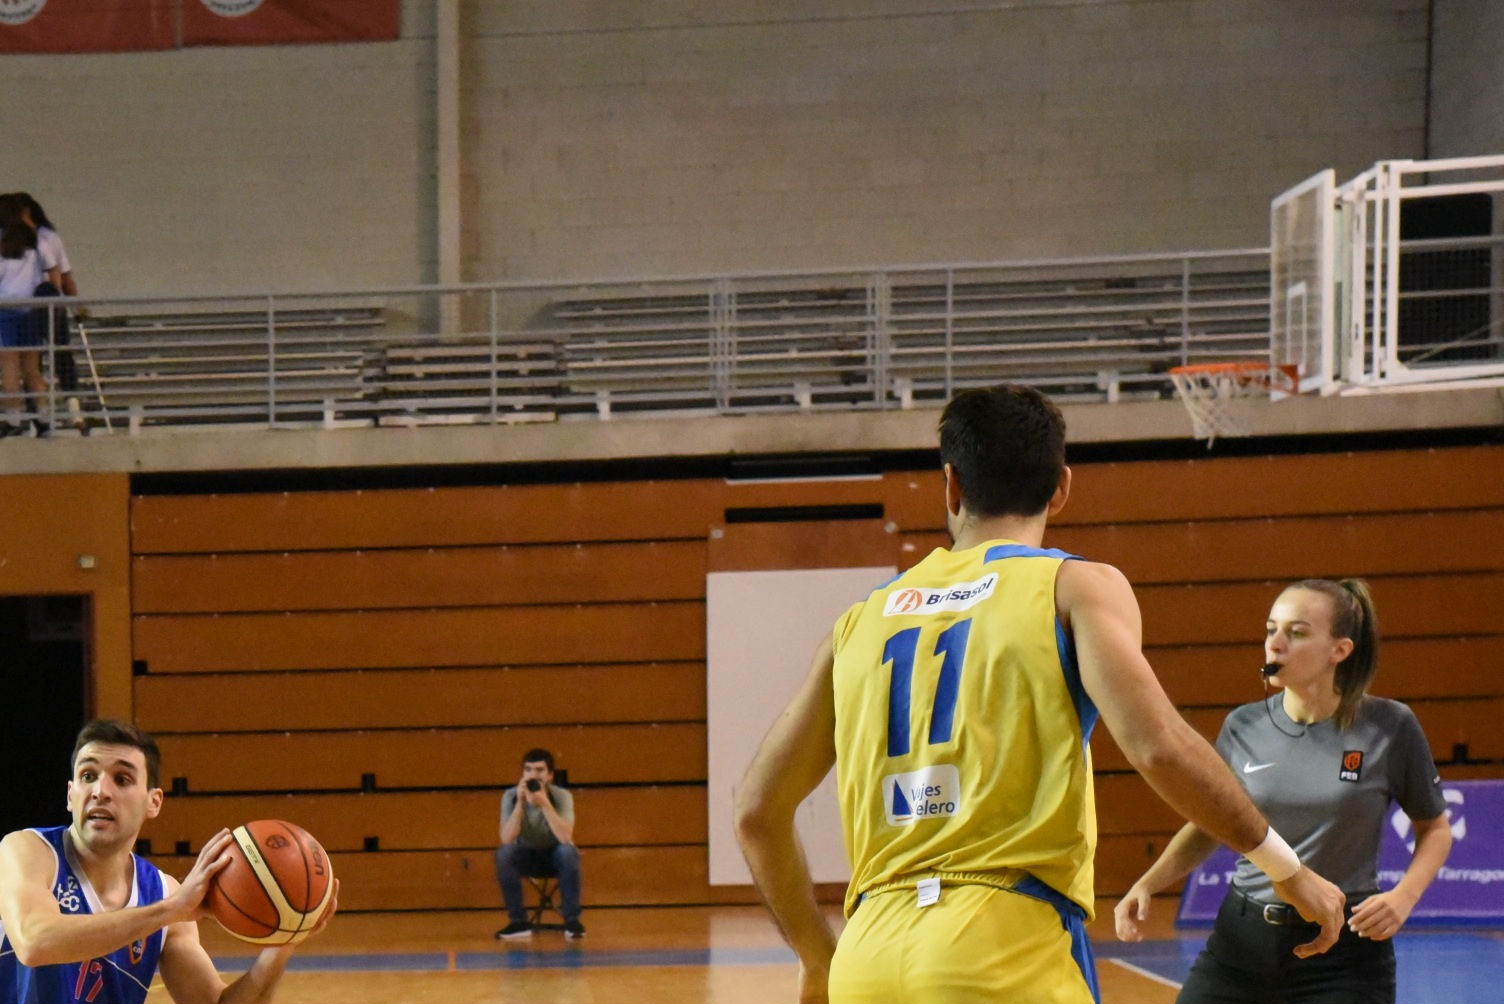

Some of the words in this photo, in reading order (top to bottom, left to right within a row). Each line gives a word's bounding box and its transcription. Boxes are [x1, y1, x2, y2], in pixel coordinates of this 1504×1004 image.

[925, 577, 994, 605] Brisasol
[882, 617, 973, 758] 11
[914, 799, 956, 816] elero
[1437, 866, 1504, 885] Tarrago
